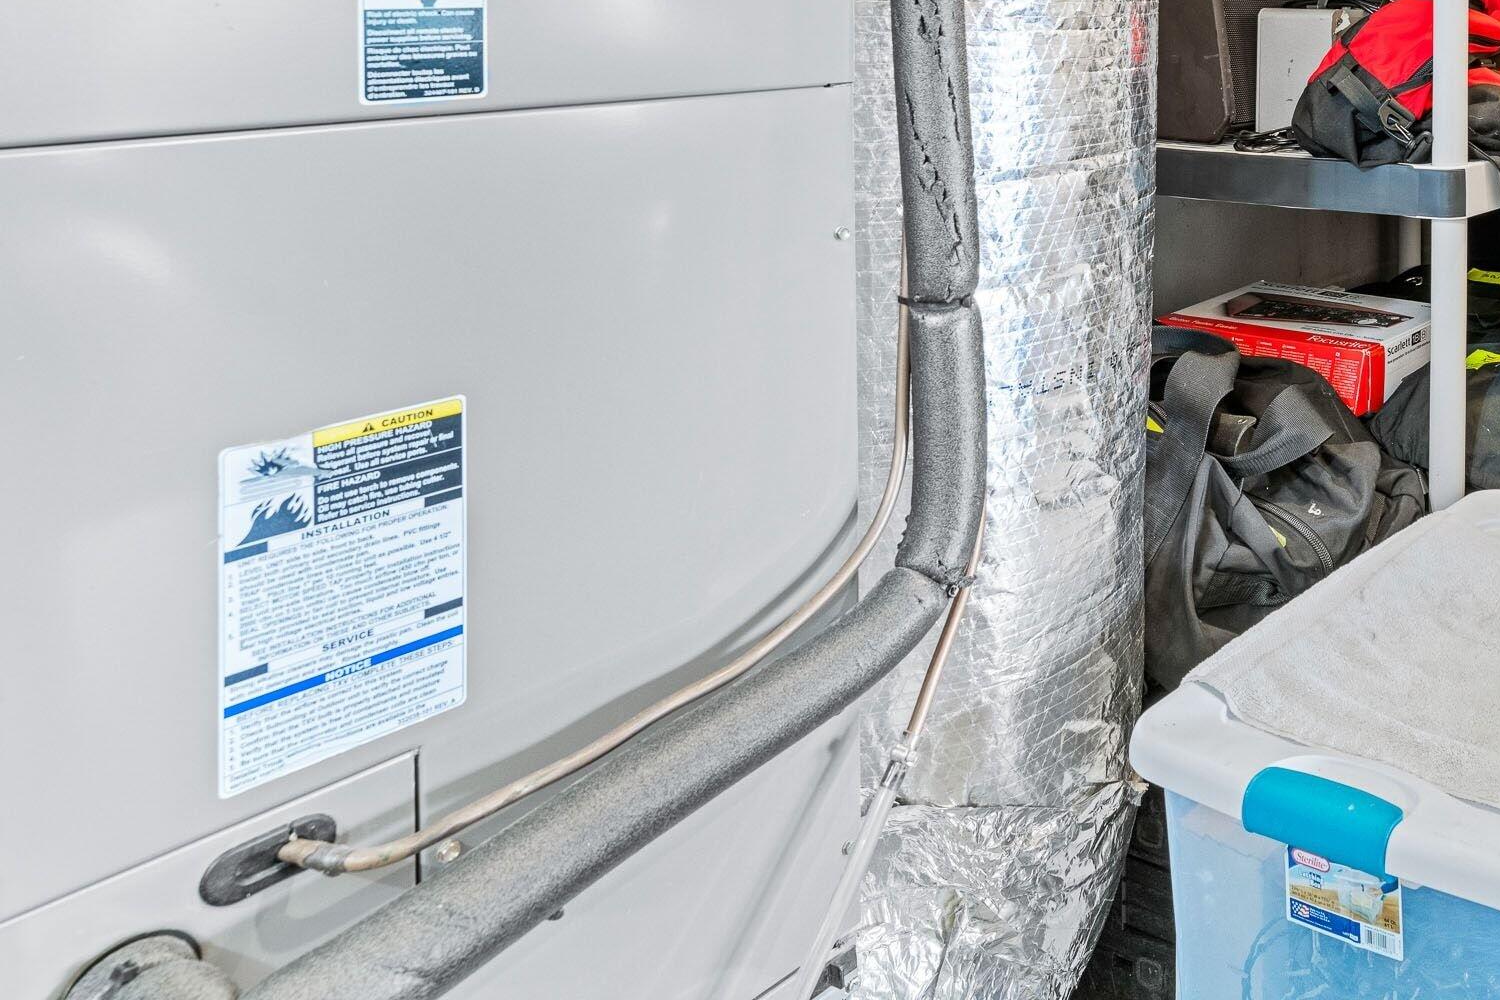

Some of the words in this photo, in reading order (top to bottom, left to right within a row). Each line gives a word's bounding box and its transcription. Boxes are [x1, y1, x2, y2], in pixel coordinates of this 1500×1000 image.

[1387, 336, 1411, 357] Scarlett
[382, 408, 433, 428] CAUTION
[317, 442, 341, 454] HIGH
[343, 429, 393, 448] PRESSURE
[395, 420, 432, 435] HAZARD
[318, 480, 339, 494] FIRE
[341, 470, 380, 488] HAZARD
[301, 508, 389, 540] INSTALLATION
[322, 628, 373, 652] SERVICE
[324, 657, 371, 682] NOTICE
[1297, 851, 1328, 870] Sterilite
